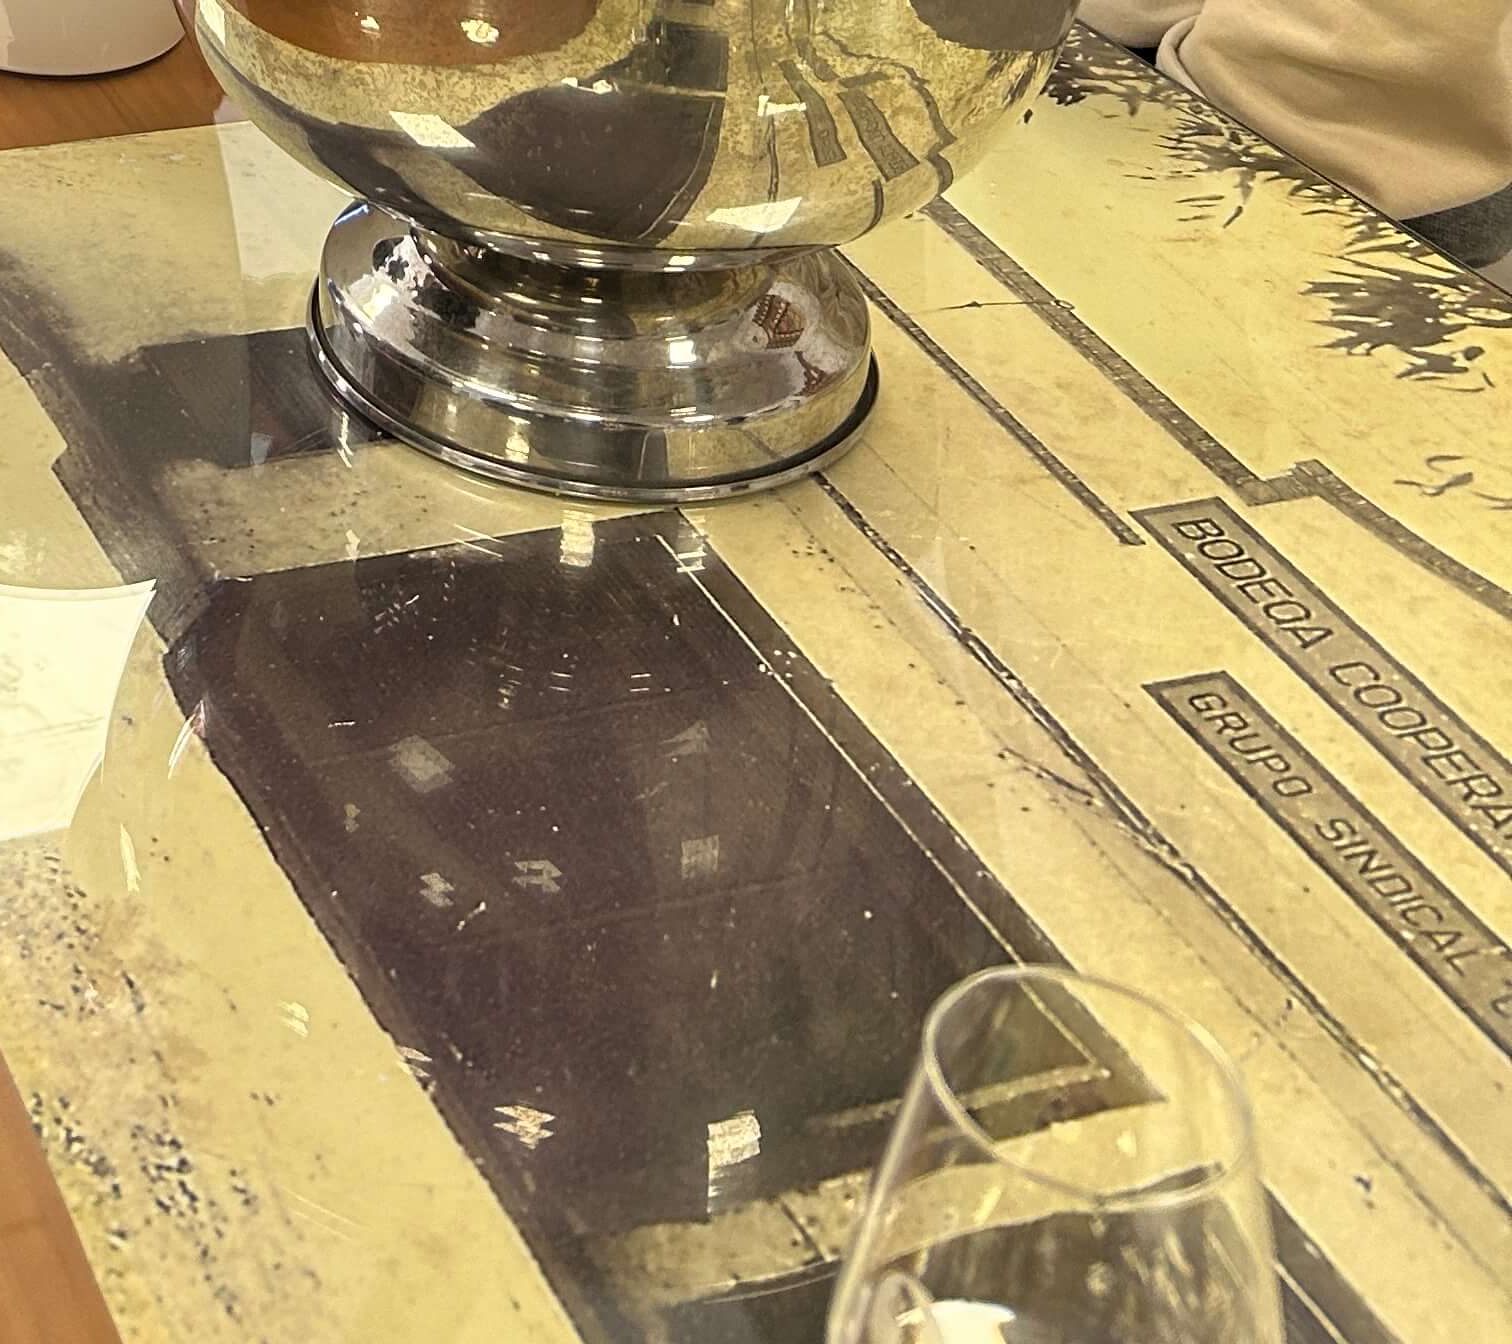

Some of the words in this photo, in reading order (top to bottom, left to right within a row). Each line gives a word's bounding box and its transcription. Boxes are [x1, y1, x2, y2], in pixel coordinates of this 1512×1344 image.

[1171, 516, 1333, 651] BODEGA
[1329, 661, 1512, 840] COOPERA
[1187, 691, 1314, 800] GRUPO
[1314, 818, 1479, 977] SINDICAL
